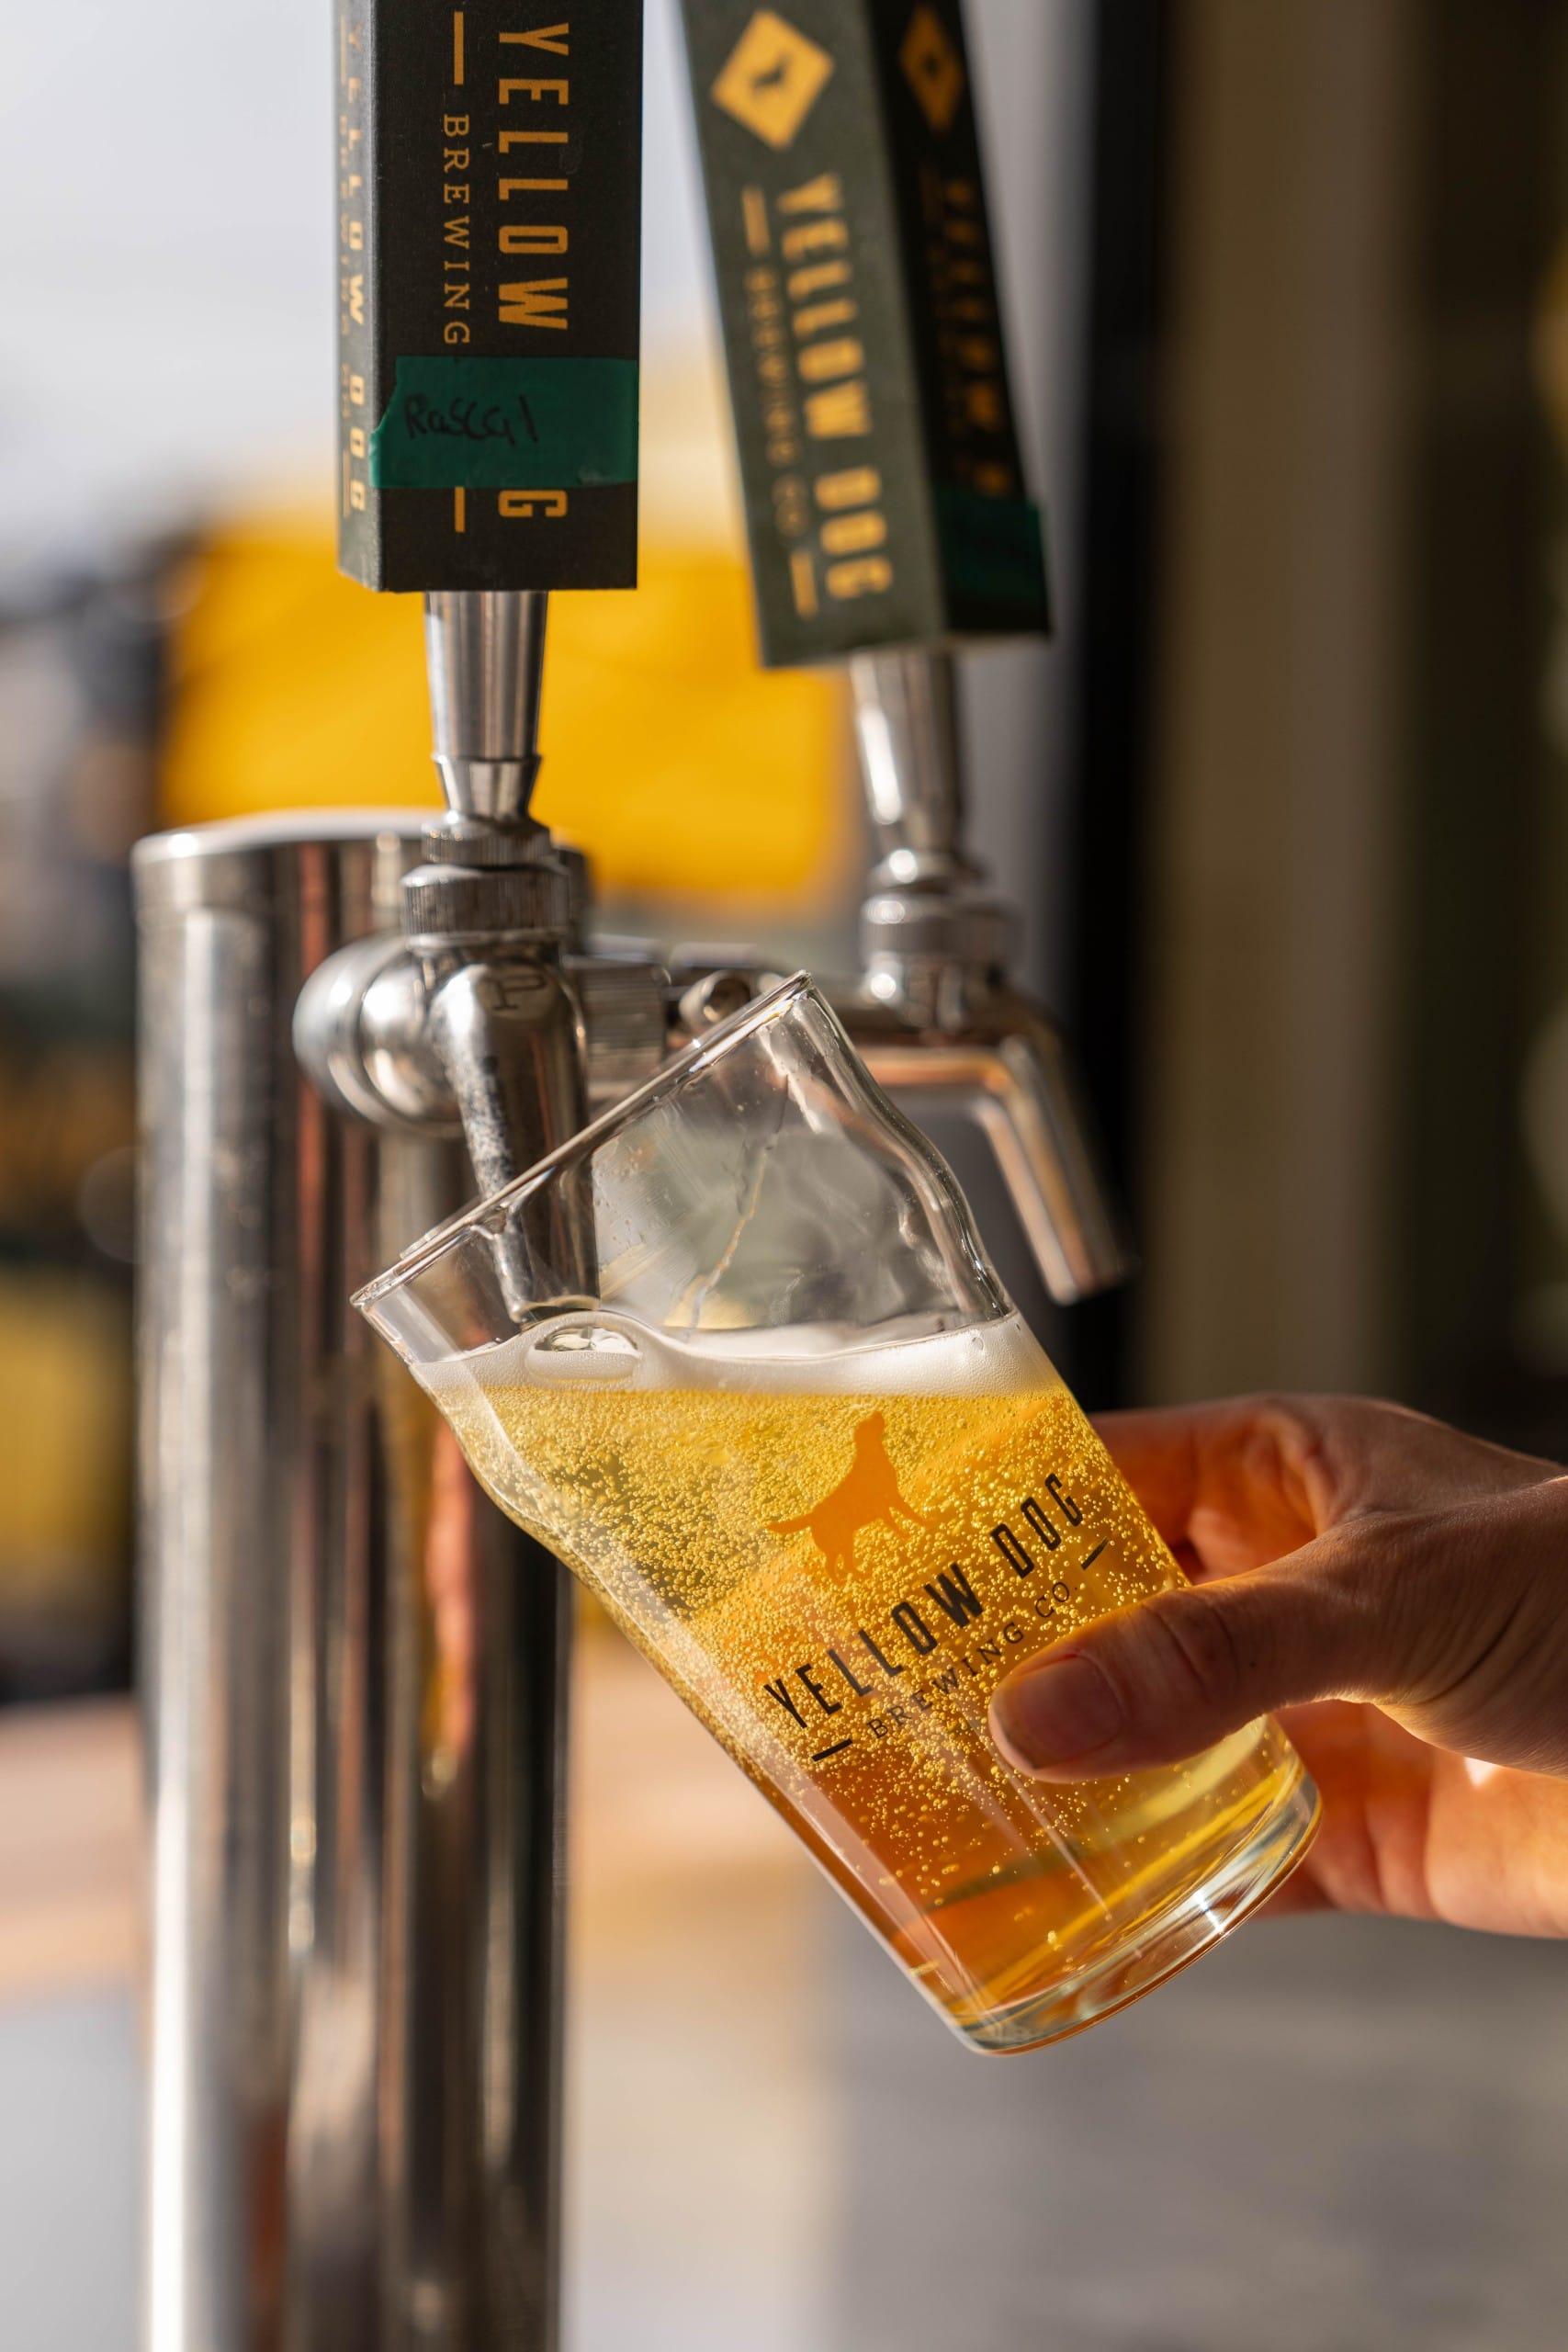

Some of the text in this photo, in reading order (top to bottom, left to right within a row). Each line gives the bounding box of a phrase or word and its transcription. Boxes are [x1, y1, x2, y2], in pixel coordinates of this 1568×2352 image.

[443, 114, 470, 345] BREWING
[498, 23, 570, 330] YELLOW
[763, 1473, 1084, 1729] YELLOW DOG
[866, 1580, 1078, 1739] BREWING CO.
